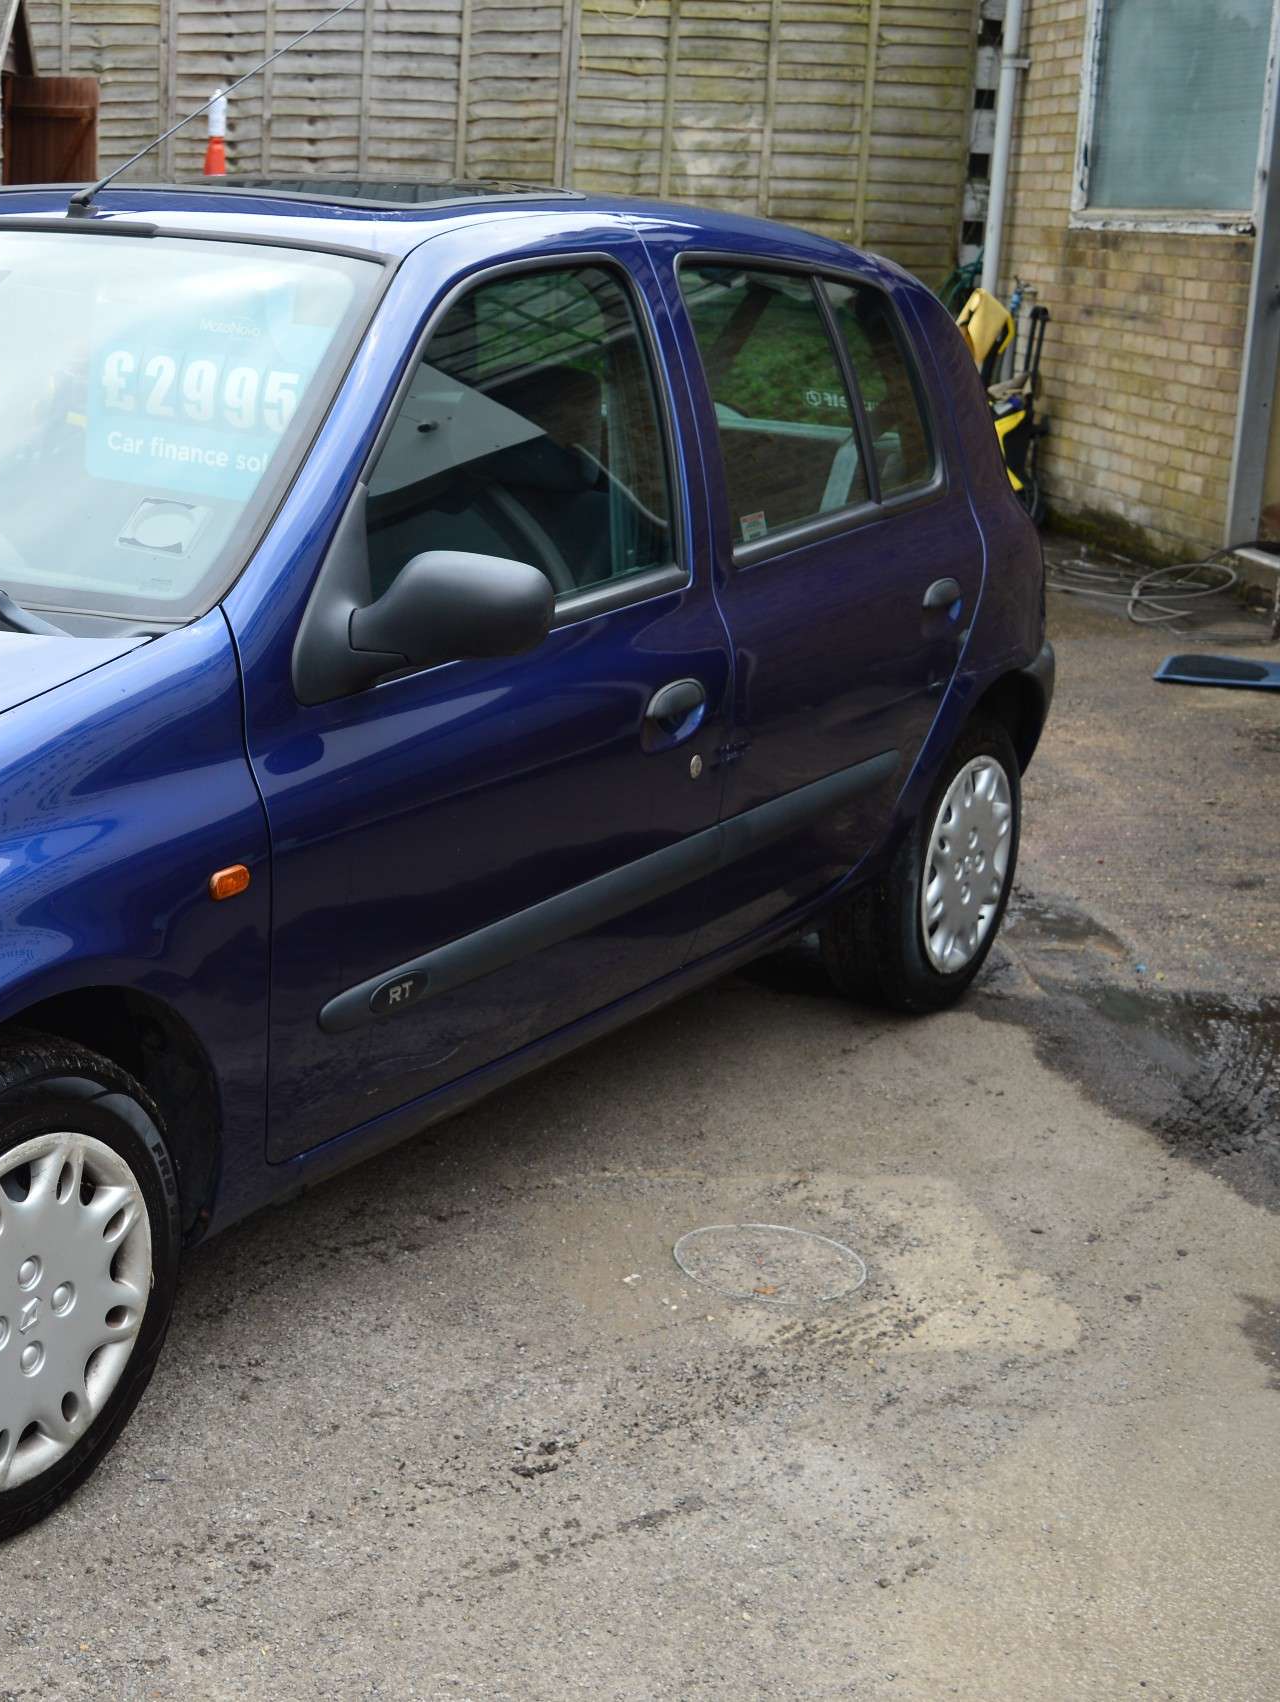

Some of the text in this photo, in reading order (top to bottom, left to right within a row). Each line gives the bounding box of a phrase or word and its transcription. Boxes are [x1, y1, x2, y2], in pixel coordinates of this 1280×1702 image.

[102, 350, 300, 433] £2995
[107, 431, 144, 455] Car
[150, 435, 229, 468] finance
[388, 980, 414, 1005] RT
